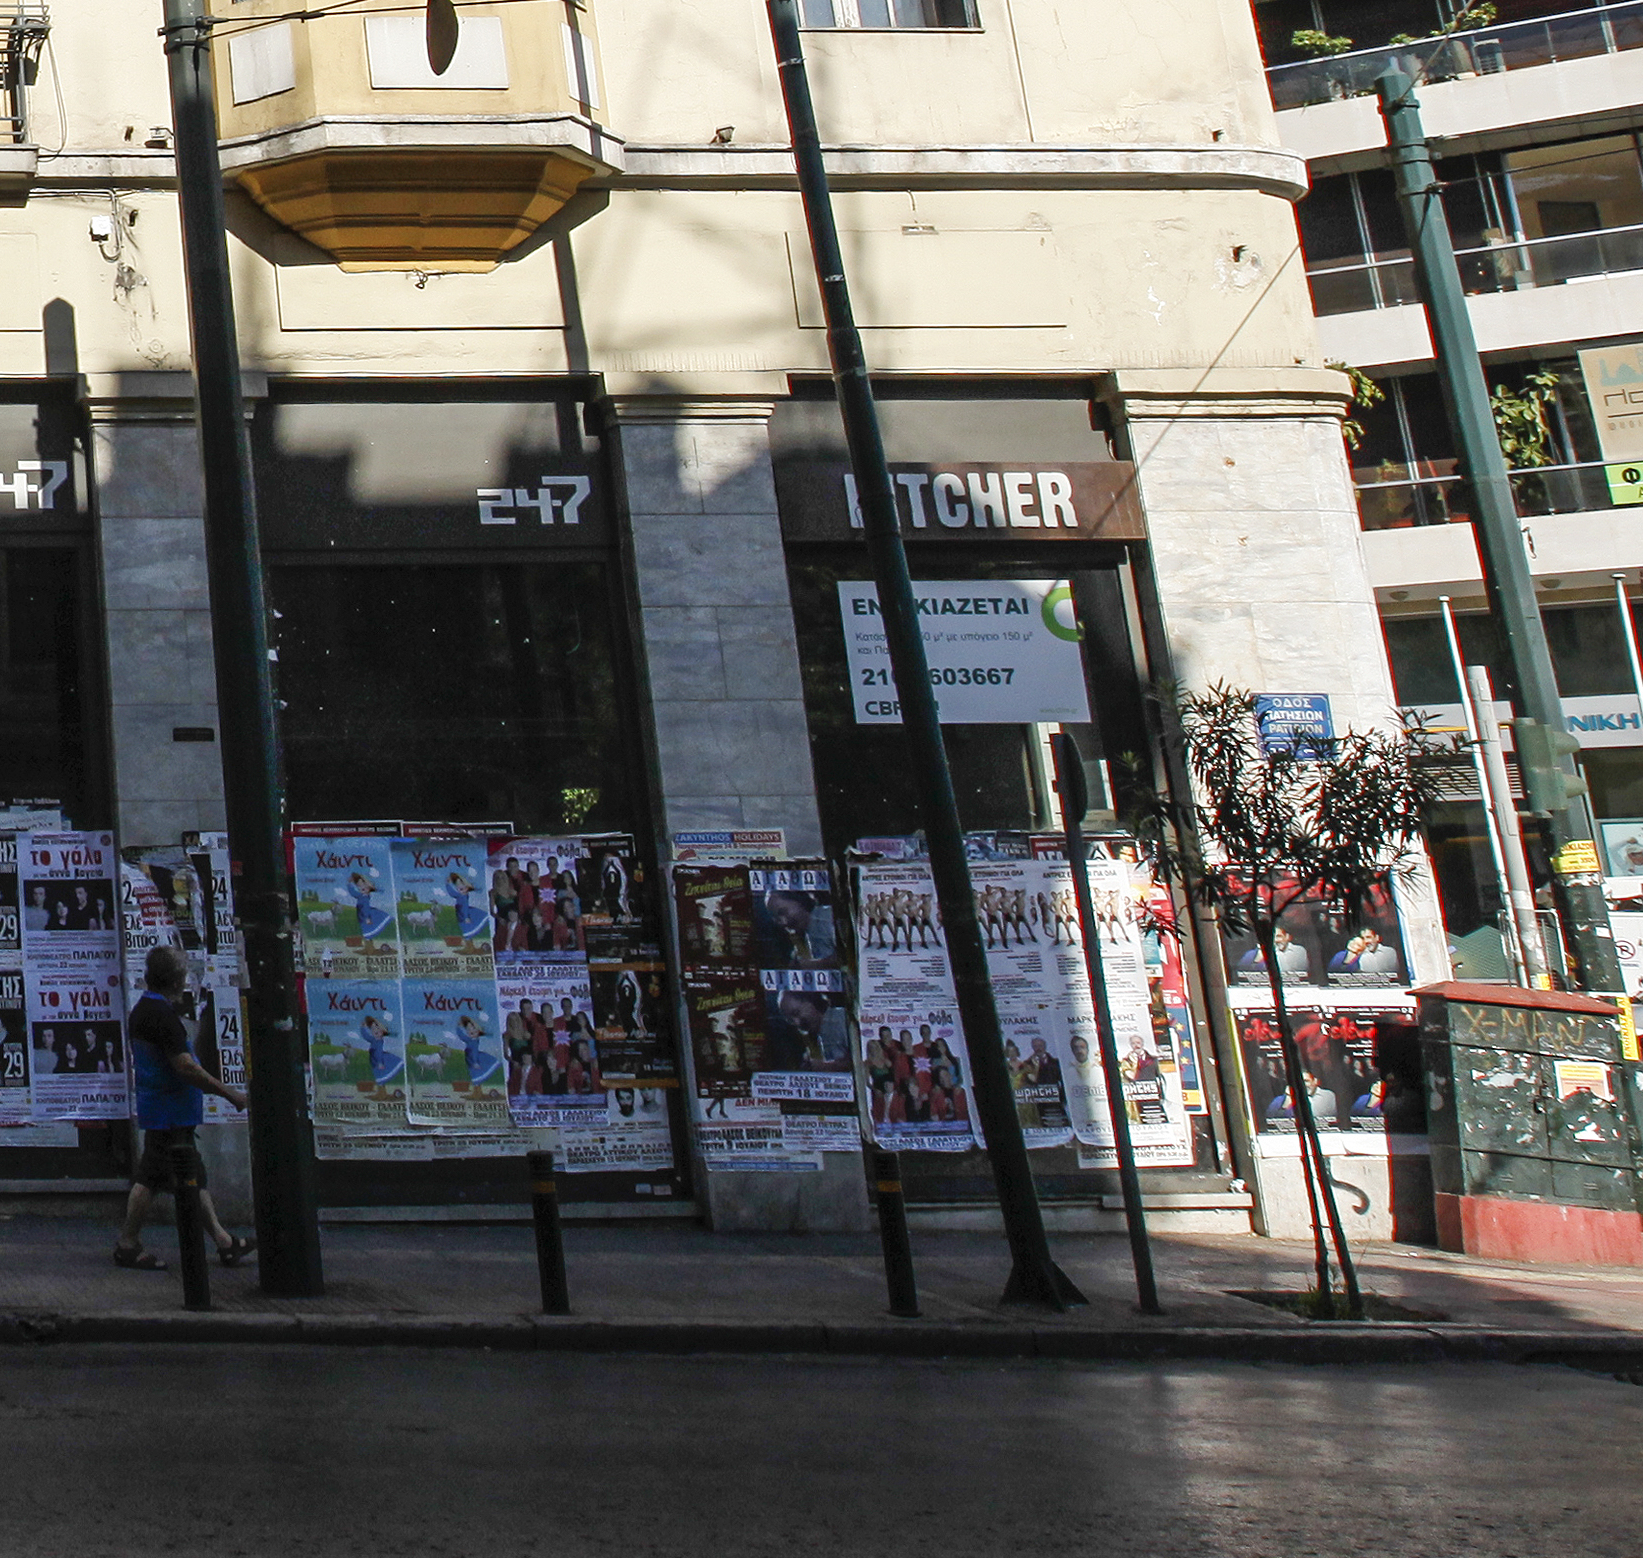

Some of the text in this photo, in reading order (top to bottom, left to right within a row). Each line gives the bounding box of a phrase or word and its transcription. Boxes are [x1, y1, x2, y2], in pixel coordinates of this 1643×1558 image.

[844, 472, 1079, 529] TCHER
[852, 598, 1030, 616] ΕΝΚΙΑΖΕΤΑΙ
[861, 668, 1015, 685] 21 603667
[1273, 698, 1312, 708] ΟΔΟΣ
[1568, 712, 1641, 732] ΝΙΚΗ
[30, 846, 102, 869] το γάλα
[316, 850, 374, 869] Χάιντι
[411, 850, 471, 869] Χάιντι
[752, 872, 828, 885] ΑΓΑΘΩΝ
[765, 971, 842, 986] ΑΓΑΘΩΝ
[40, 989, 110, 1011] το γάλα
[327, 991, 387, 1011] Χάιντι
[423, 991, 483, 1011] Χάιντι
[220, 1015, 239, 1039] 24
[1067, 1013, 1137, 1024] ΜΑΡΚΑΚΗΣ
[3, 1052, 24, 1078] 29
[222, 1048, 245, 1066] Ελέν
[797, 1088, 811, 1098] 18
